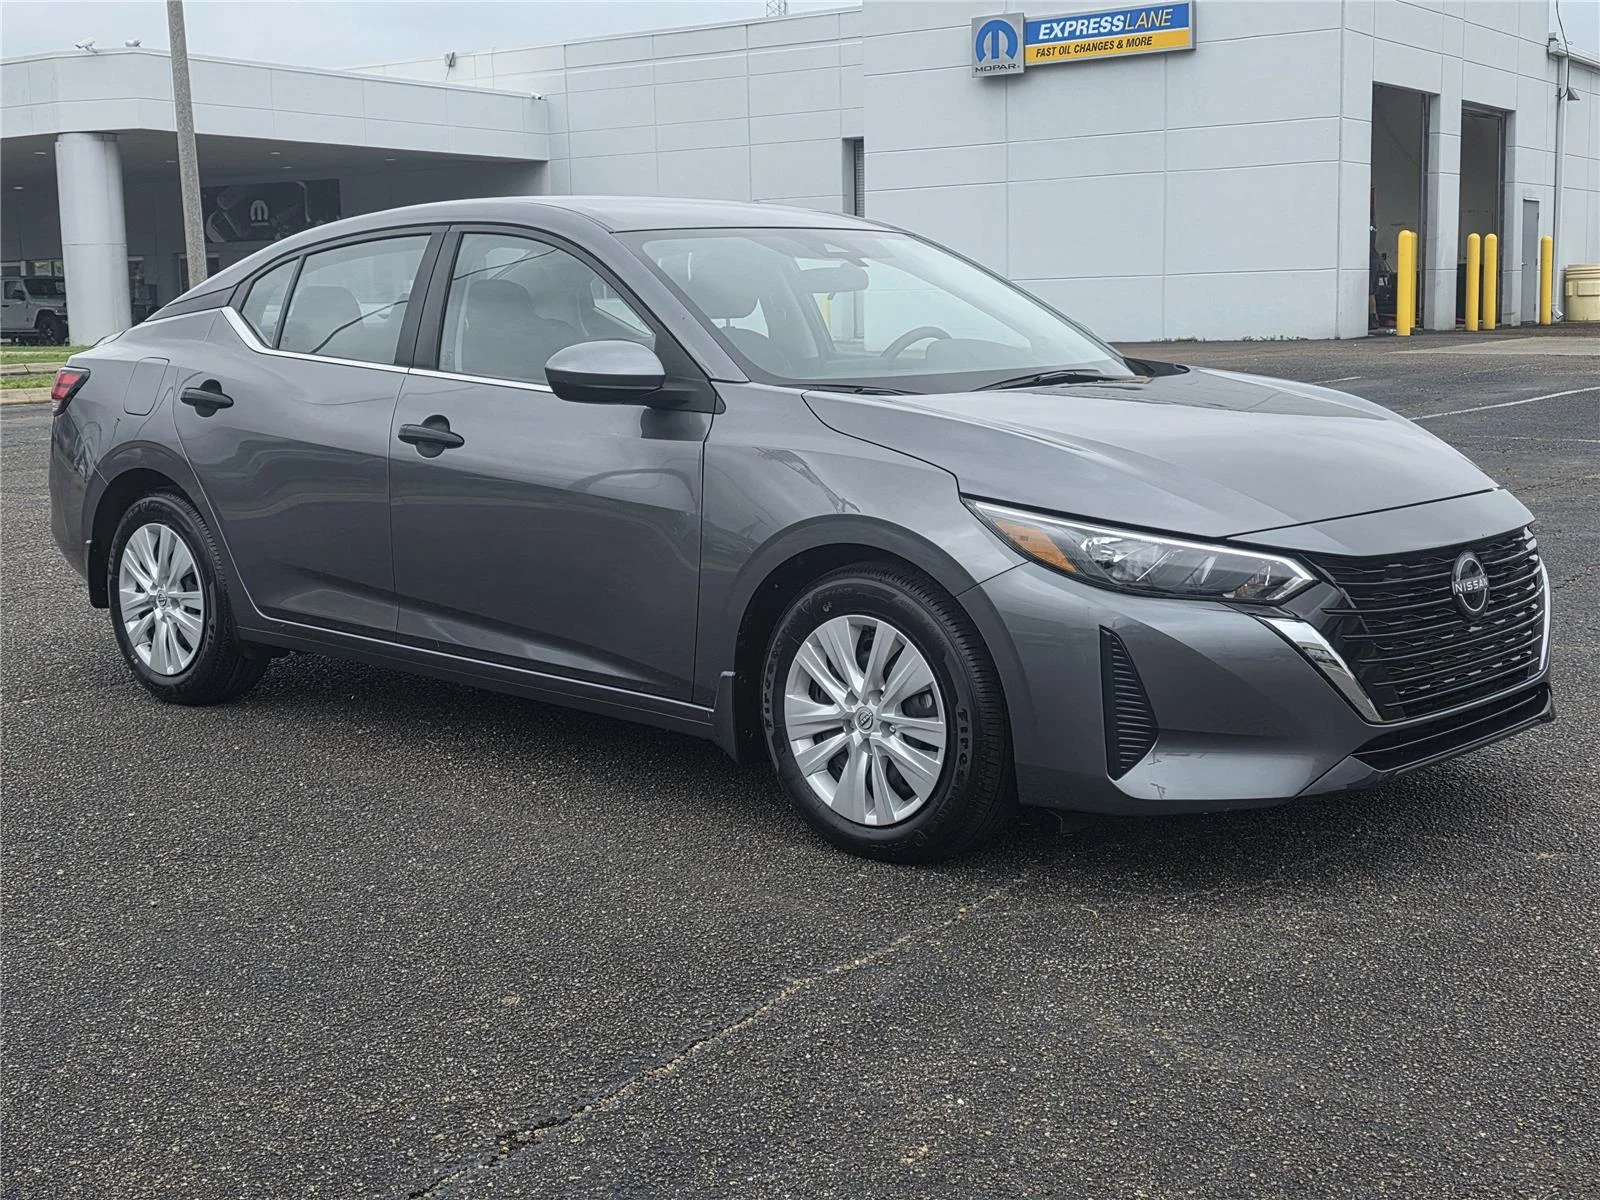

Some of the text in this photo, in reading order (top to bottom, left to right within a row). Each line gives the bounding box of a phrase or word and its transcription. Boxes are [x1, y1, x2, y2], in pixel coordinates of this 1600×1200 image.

[1035, 36, 1153, 58] FAST OIL CHANGES & MORE
[975, 63, 1017, 73] MOPAR
[1455, 578, 1488, 593] NISSAN
